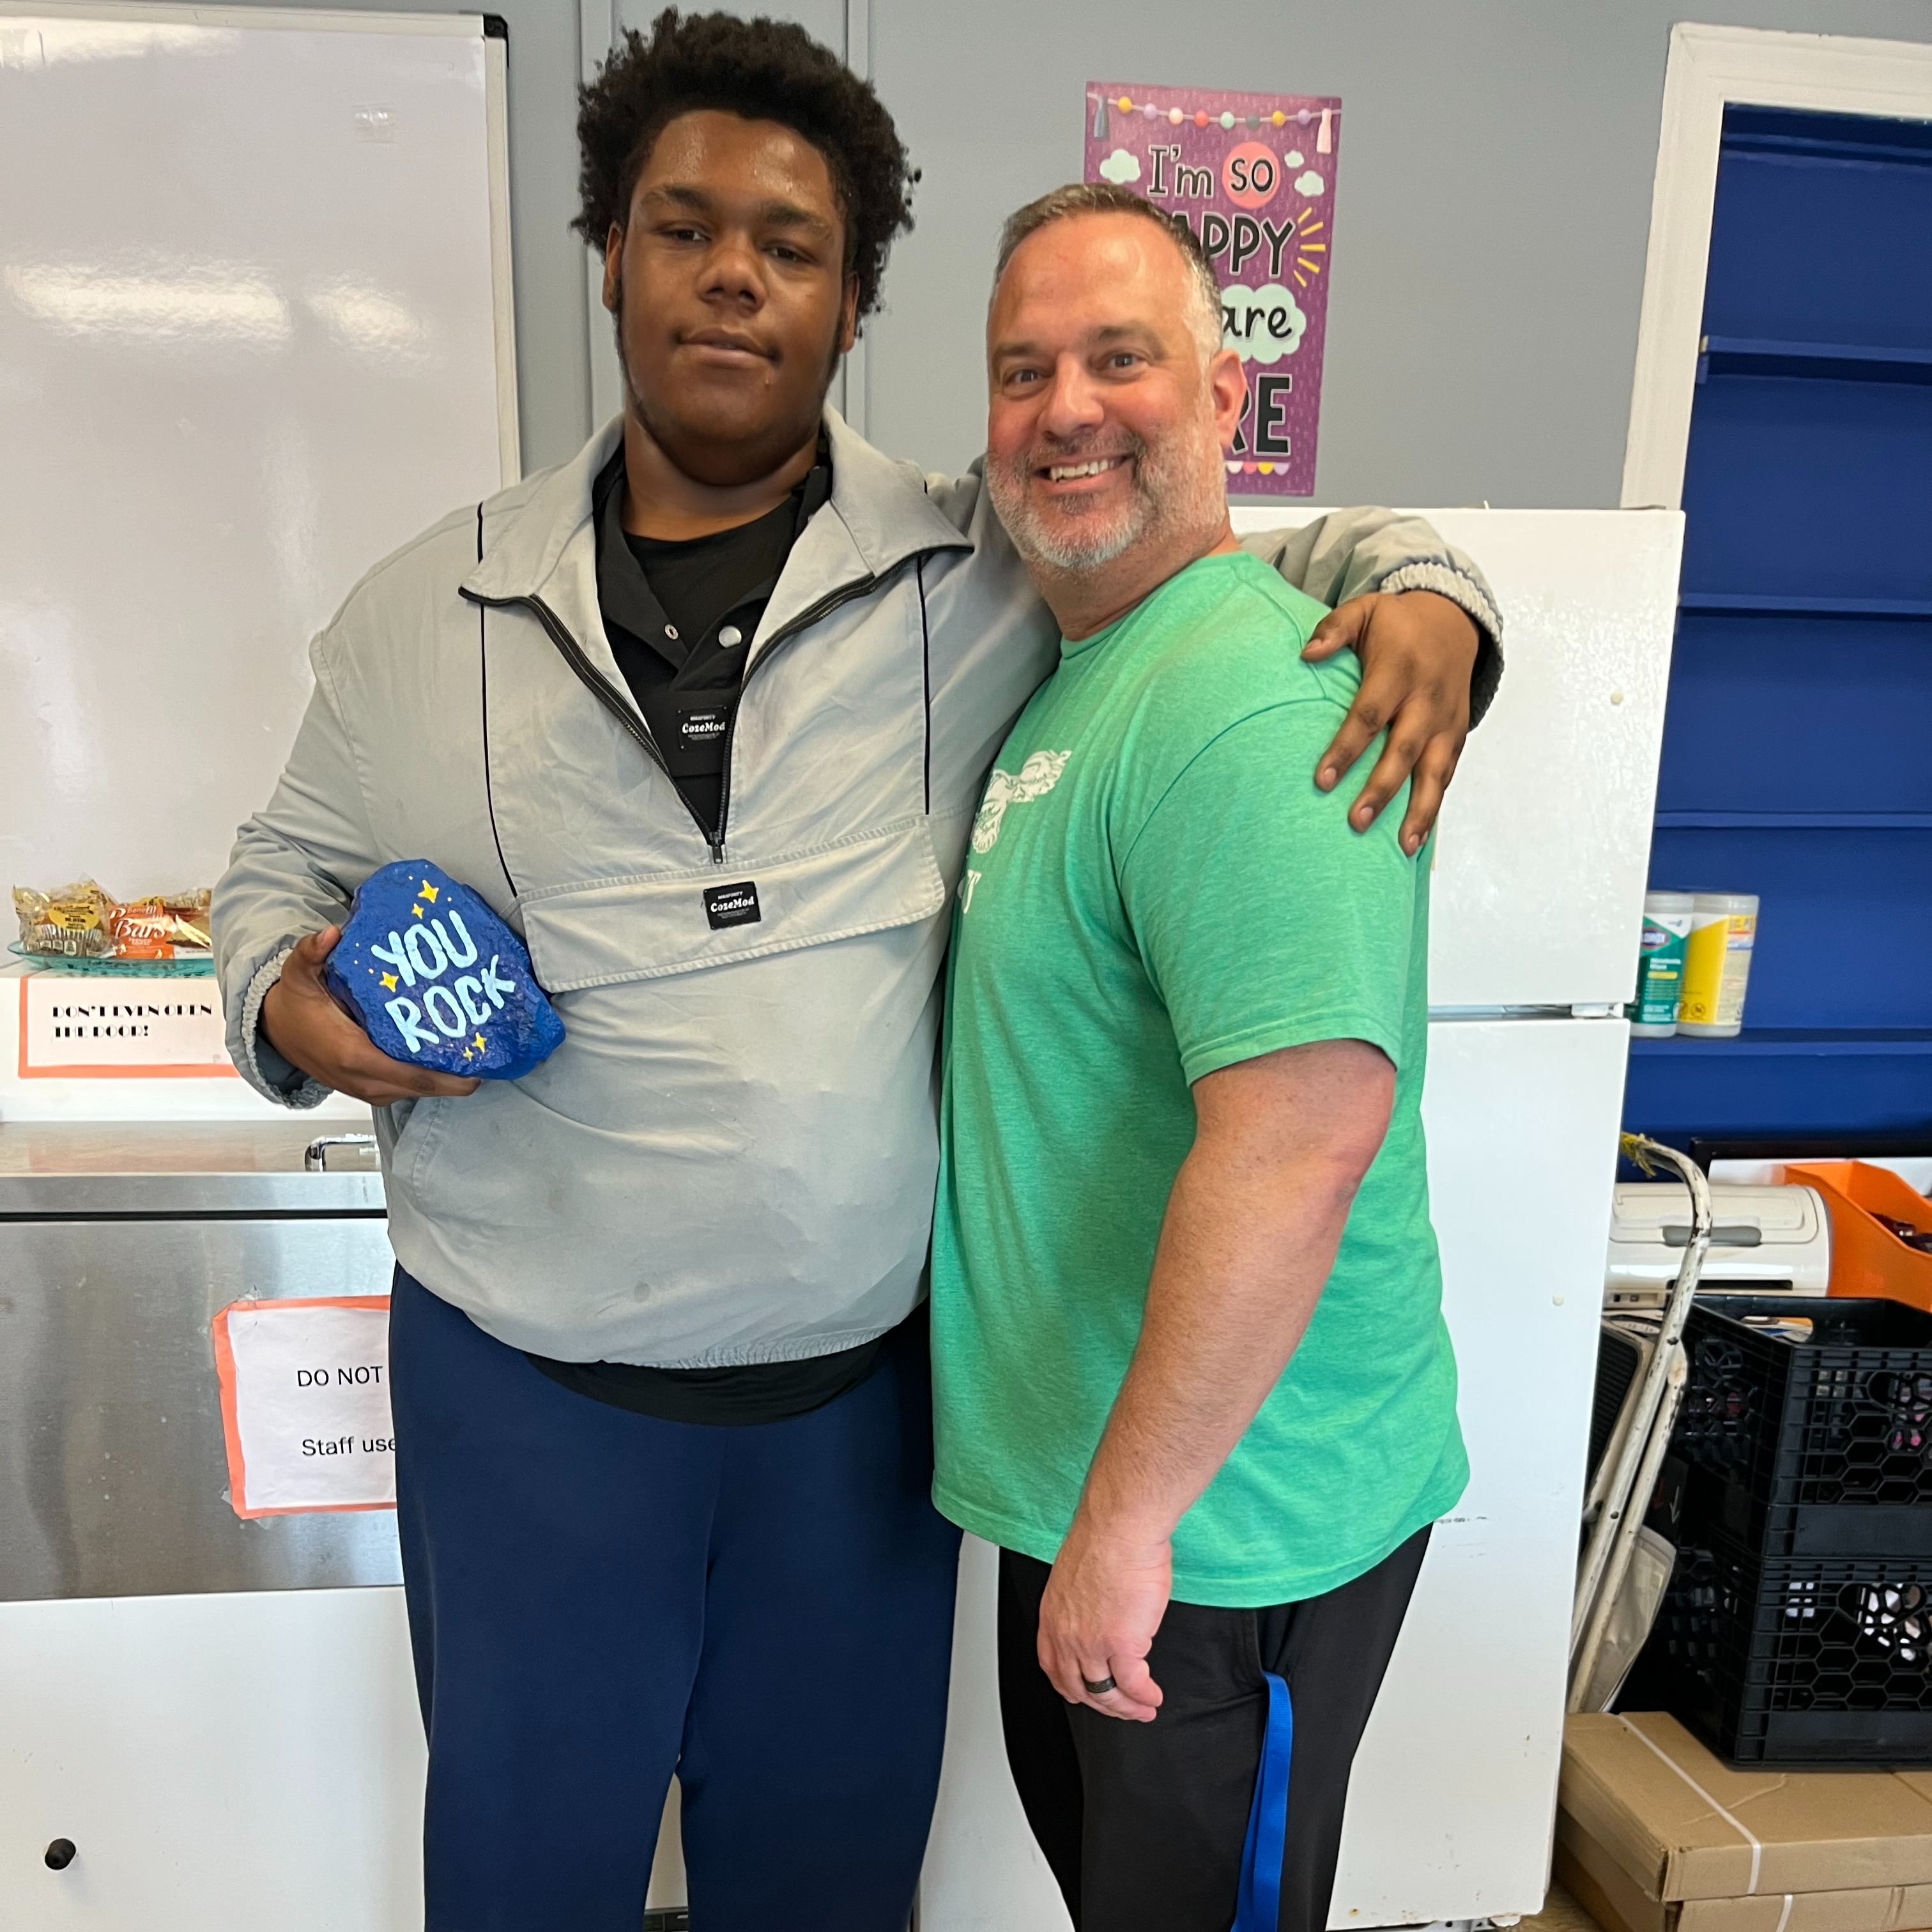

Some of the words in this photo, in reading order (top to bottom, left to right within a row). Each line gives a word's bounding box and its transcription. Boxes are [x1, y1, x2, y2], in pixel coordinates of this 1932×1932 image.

[1148, 146, 1213, 197] I'm
[371, 910, 478, 987] YOU
[53, 1005, 108, 1018] DON'T
[112, 1004, 160, 1018] EVEN
[164, 1003, 212, 1016] OPEN
[385, 954, 516, 1053] ROCK
[52, 1025, 88, 1039] THE
[93, 1024, 149, 1038] DOOR!
[297, 1370, 329, 1387] DO
[337, 1365, 383, 1385] NOT
[302, 1436, 355, 1456] Staff
